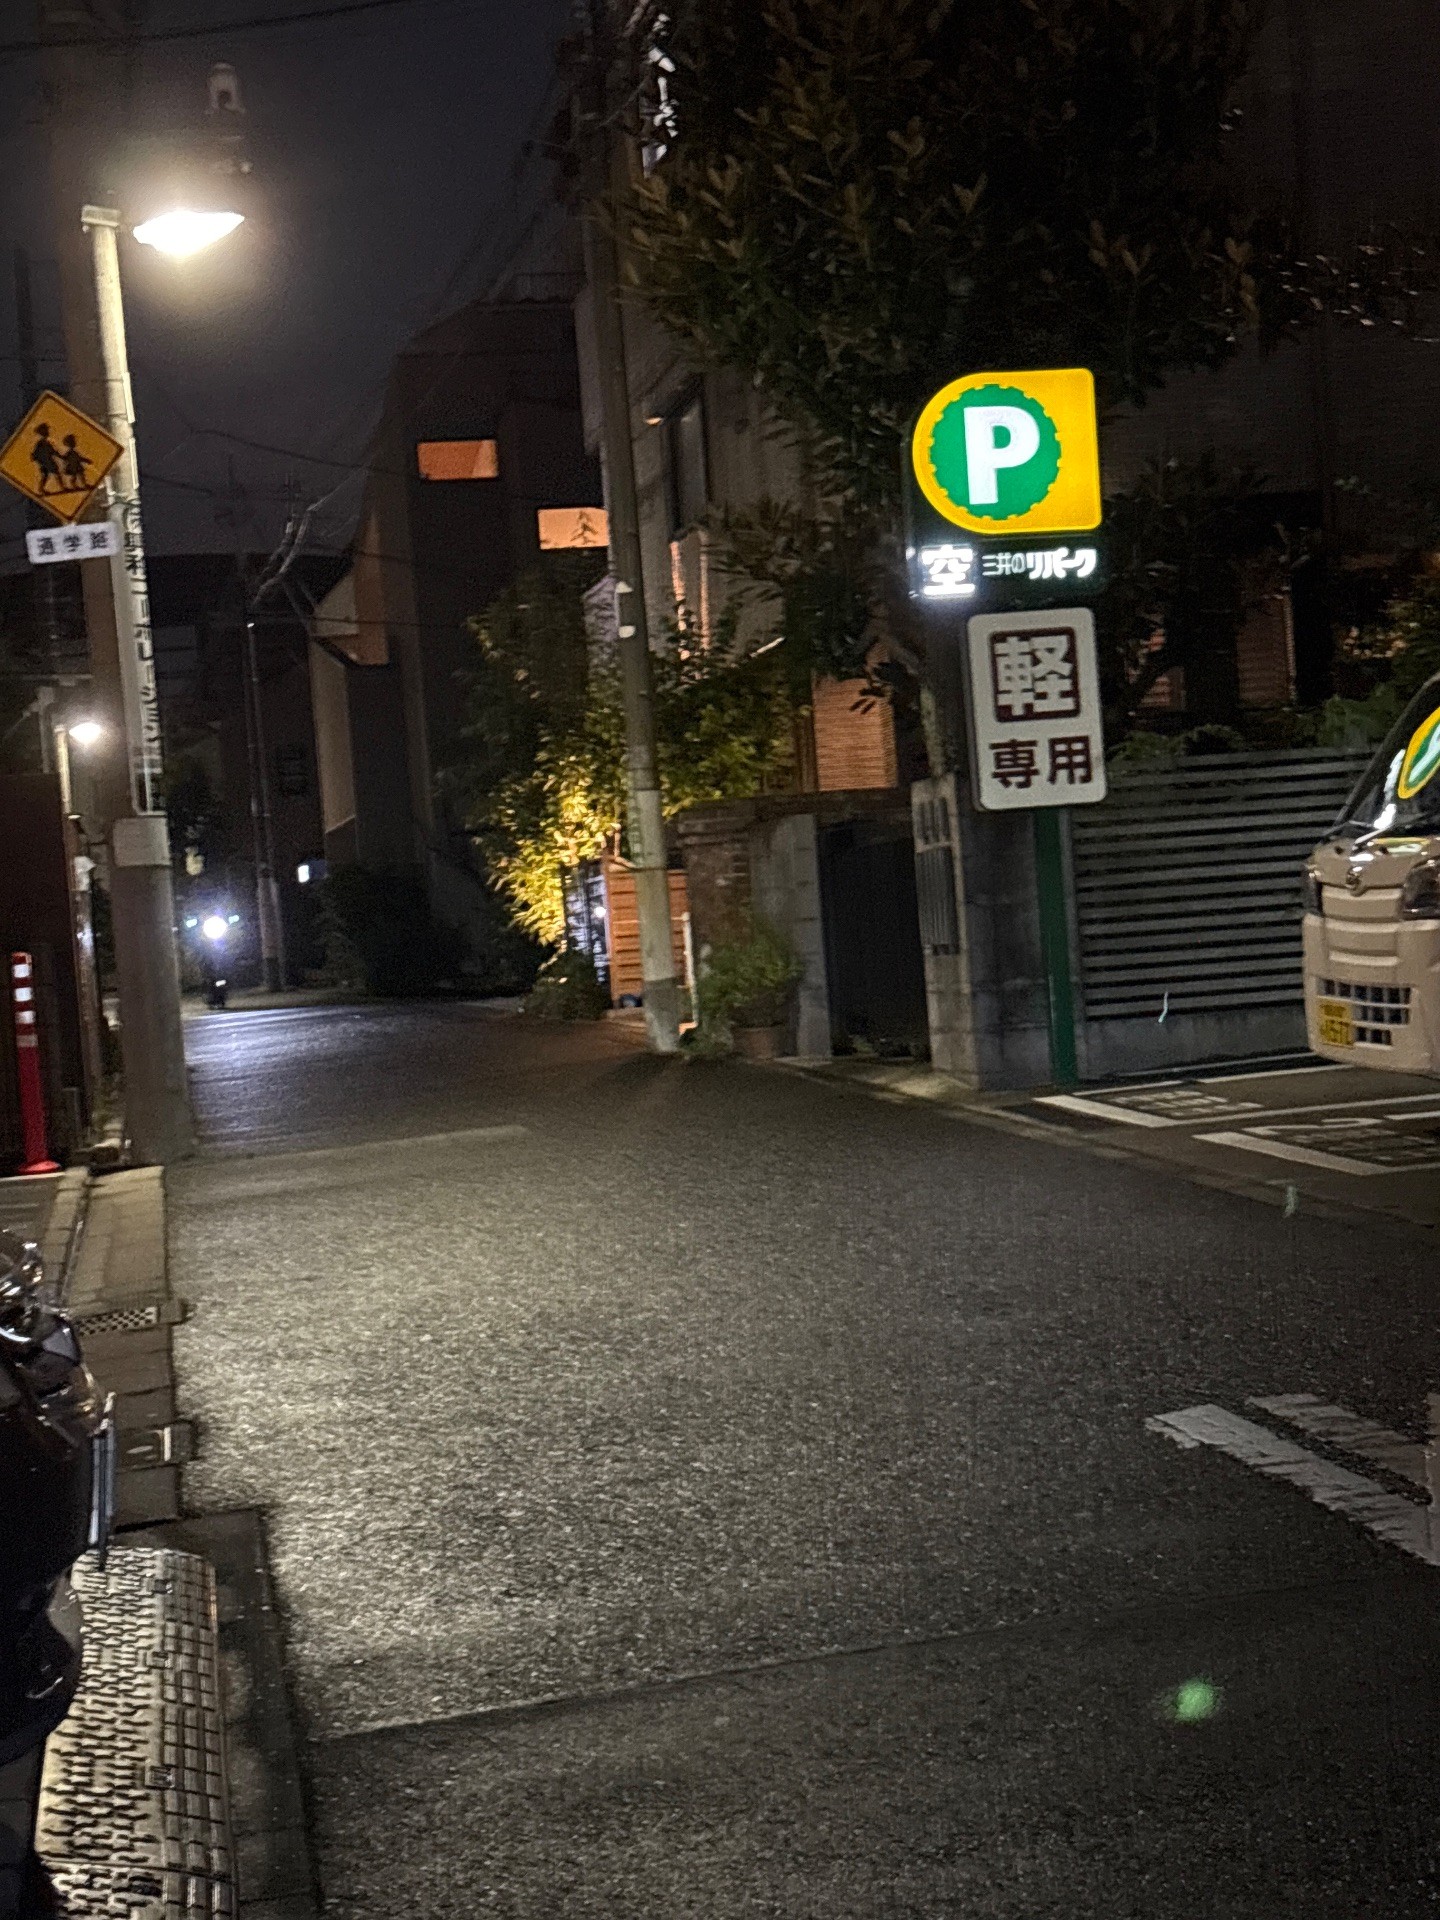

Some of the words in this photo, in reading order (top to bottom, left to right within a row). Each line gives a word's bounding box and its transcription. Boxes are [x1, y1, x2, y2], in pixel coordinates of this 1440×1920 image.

[964, 406, 1040, 505] P
[921, 545, 976, 595] 空
[993, 634, 1076, 717] 軽
[989, 736, 1093, 789] 専用
